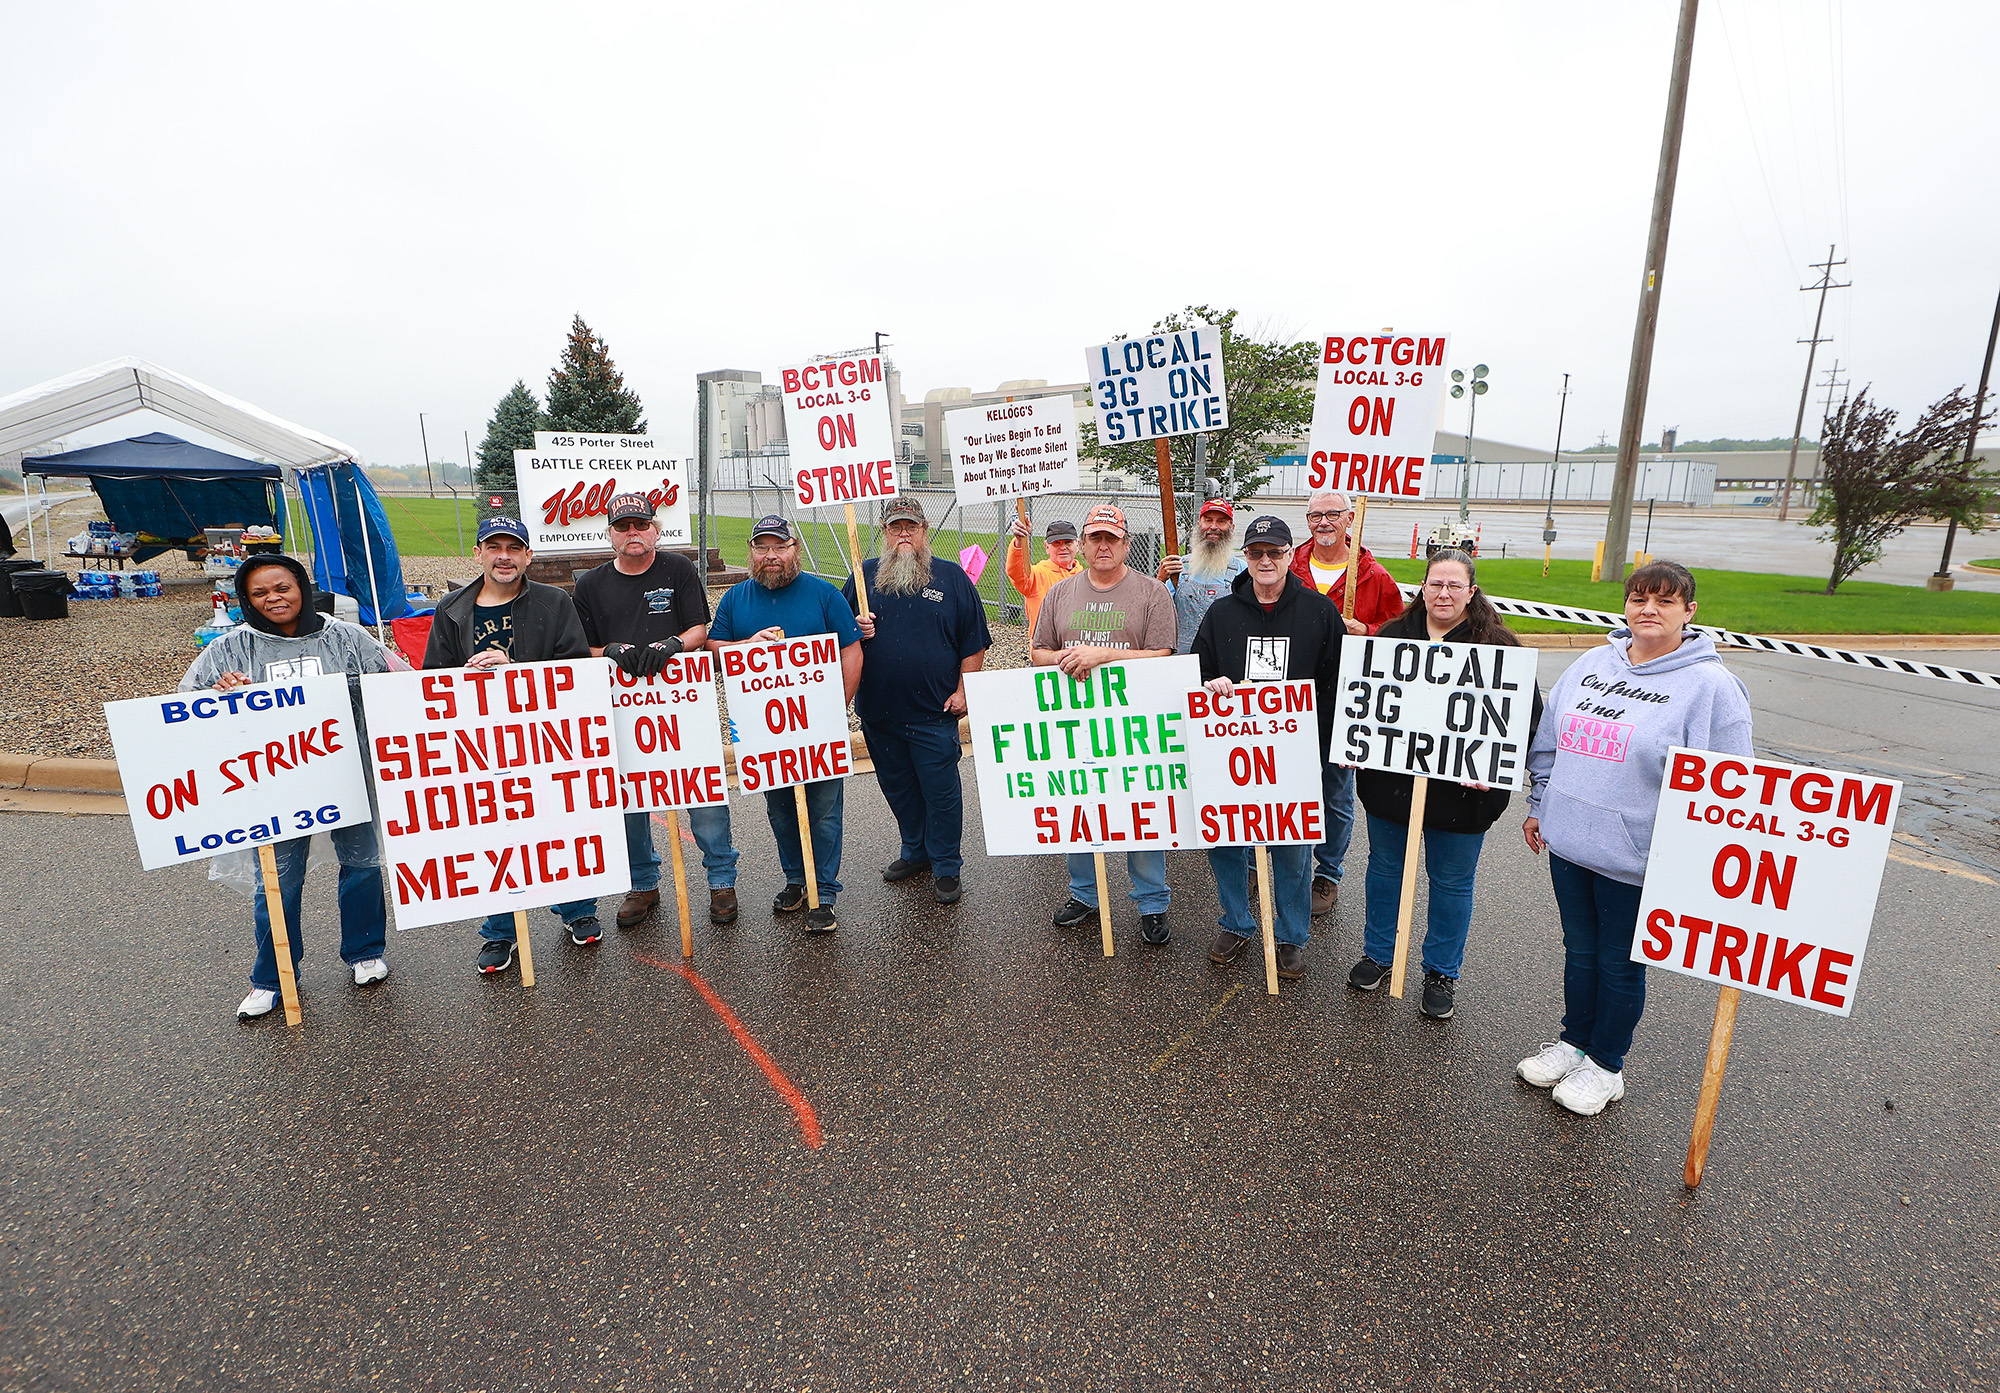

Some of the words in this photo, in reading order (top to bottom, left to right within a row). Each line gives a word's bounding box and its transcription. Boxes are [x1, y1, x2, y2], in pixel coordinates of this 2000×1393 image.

[1101, 331, 1211, 377] LOCAL
[1323, 337, 1446, 366] BCTGM
[782, 358, 882, 393] BCTGM
[1098, 377, 1139, 410] 3G
[1168, 364, 1211, 399] ON
[1333, 370, 1389, 386] LOCAL
[1394, 372, 1423, 387] 3-G
[797, 392, 844, 409] LOCAL
[848, 388, 871, 403] 3-G
[986, 405, 1034, 422] KELLOGG'S
[1106, 396, 1222, 441] STRIKE
[1348, 395, 1395, 437] ON
[551, 437, 575, 447] 425
[580, 437, 615, 448] Porter
[620, 438, 654, 448] Street
[818, 413, 857, 451] ON
[963, 435, 982, 447] "Our
[985, 433, 1006, 445] Lives
[1008, 428, 1032, 442] Begin
[1034, 426, 1044, 437] To
[1046, 423, 1062, 436] End
[531, 458, 583, 470] BATTLE
[589, 459, 632, 470] CREEK
[637, 459, 678, 470] PLANT
[960, 454, 976, 466] The
[978, 452, 994, 464] Day
[995, 449, 1008, 461] We
[1010, 446, 1042, 459] Become
[1044, 441, 1068, 453] Silent
[963, 470, 987, 483] About
[989, 467, 1016, 479] Things
[1018, 463, 1037, 475] That
[1039, 458, 1068, 471] Matter"
[797, 460, 895, 504] STRIKE
[986, 486, 998, 497] Dr.
[1000, 484, 1010, 495] M.
[1012, 482, 1020, 493] L.
[1022, 480, 1040, 492] King
[1042, 478, 1053, 488] Jr.
[1308, 451, 1425, 497] STRIKE
[542, 478, 680, 526] Kellg's
[539, 533, 606, 543] EMPLOYEE/VI
[660, 529, 683, 538] ANCE
[1070, 611, 1126, 630] ARGUING
[1086, 602, 1097, 612] I'M
[1098, 602, 1114, 612] NOT
[1080, 630, 1091, 640] I'M
[1092, 631, 1111, 641] JUST
[724, 638, 837, 677] BCTGM
[1362, 640, 1518, 691] LOCAL
[421, 666, 574, 720] STOP
[612, 691, 666, 708] LOCAL
[671, 689, 698, 704] 3-G
[741, 674, 795, 693] LOCAL
[799, 670, 825, 685] 3-G
[1034, 666, 1129, 712] OUR
[1187, 684, 1313, 719] BCTGM
[1581, 674, 1608, 692] Our
[1602, 681, 1670, 704] future
[161, 686, 306, 724] BCTGM
[765, 695, 809, 735] ON
[1345, 681, 1402, 724] 3G
[1446, 692, 1511, 738] ON
[1576, 698, 1593, 711] is
[1591, 705, 1625, 720] not
[375, 716, 610, 781] SENDING
[635, 714, 681, 754] ON
[991, 713, 1185, 763] FUTURE
[1204, 721, 1263, 738] LOCAL
[1268, 719, 1298, 734] 3-G
[1561, 732, 1622, 758] SALE
[1568, 717, 1621, 741] FOR
[146, 769, 199, 820] ON
[219, 718, 344, 795] STRIKE
[741, 741, 849, 791] STRIKE
[1229, 746, 1277, 786] ON
[1345, 724, 1517, 785] STRIKE
[1006, 772, 1035, 798] IS
[1047, 768, 1109, 796] NOT
[1122, 763, 1188, 792] FOR
[1669, 753, 1894, 826] BCTGM
[387, 777, 535, 837] JOBS
[552, 767, 617, 813] TO
[1034, 795, 1179, 848] SALE!
[1201, 801, 1322, 843] STRIKE
[175, 816, 282, 855] Local
[293, 804, 341, 830] 3G
[1687, 801, 1786, 837] LOCAL
[1796, 821, 1850, 848] 3-G
[395, 835, 605, 905] MEXICO
[1711, 843, 1798, 911] ON
[1641, 908, 1855, 1009] STRIKE
